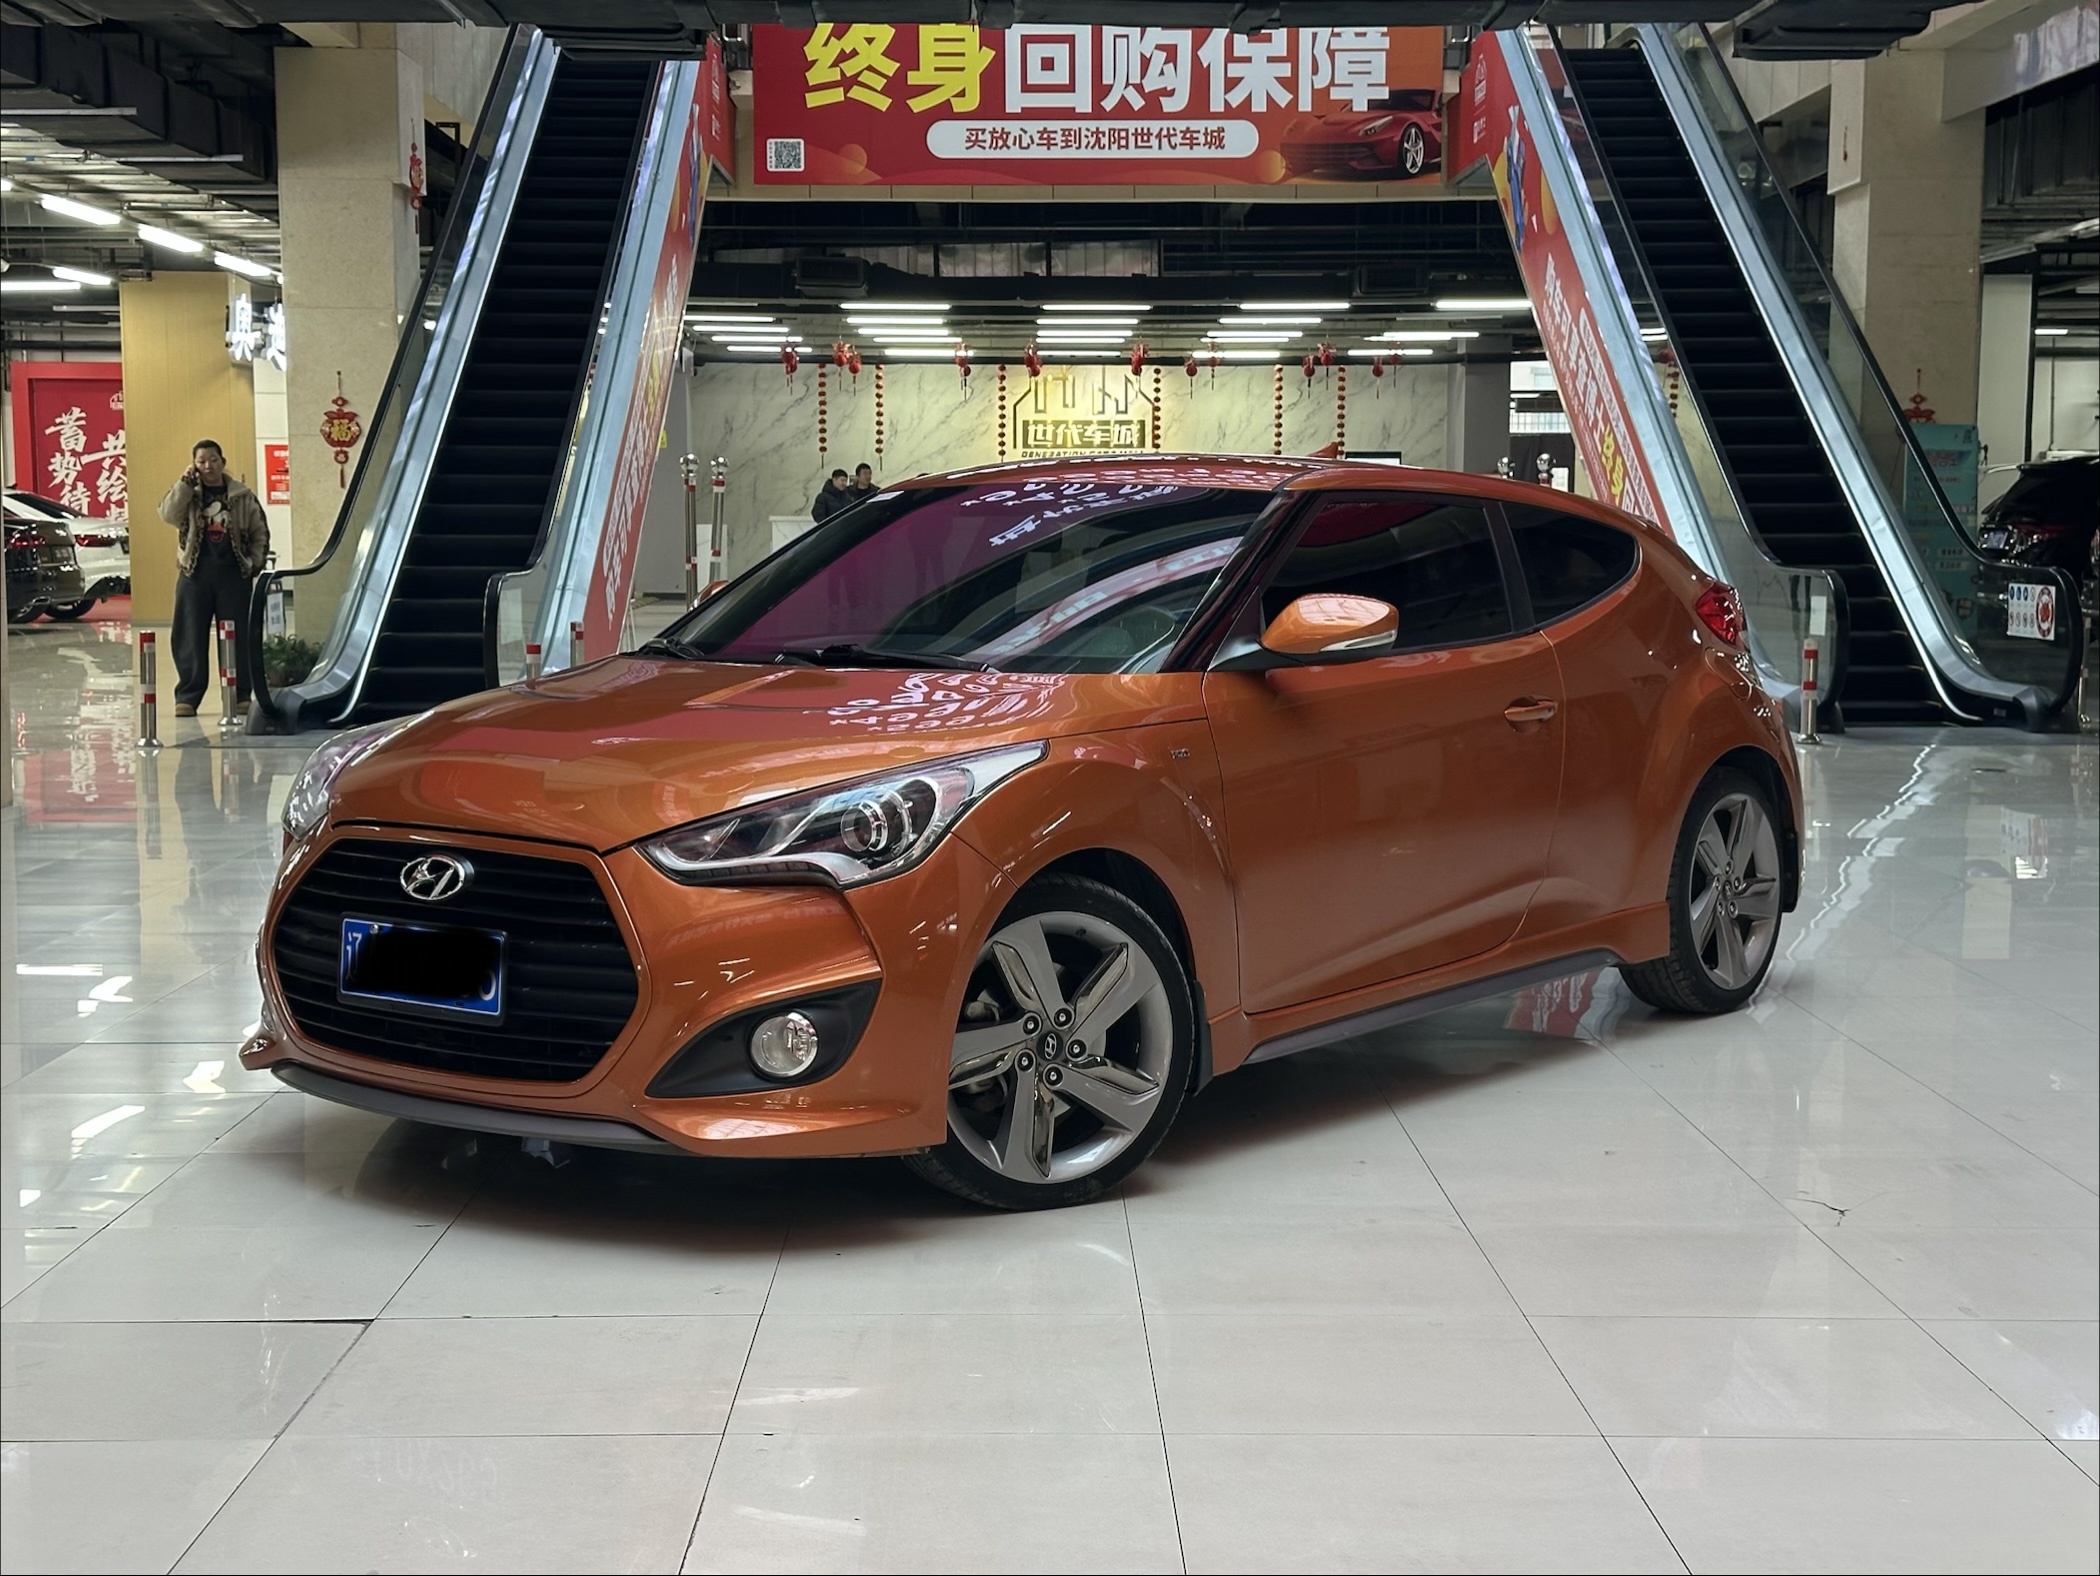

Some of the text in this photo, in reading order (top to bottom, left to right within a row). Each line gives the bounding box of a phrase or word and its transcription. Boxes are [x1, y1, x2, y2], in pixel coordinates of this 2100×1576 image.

[803, 23, 1390, 114] 终身回购保障
[965, 127, 1226, 151] 买放心车到沈阳世代车城
[1545, 252, 1638, 514] 购车可享查博士终身回
[1027, 423, 1141, 446] 世代车城
